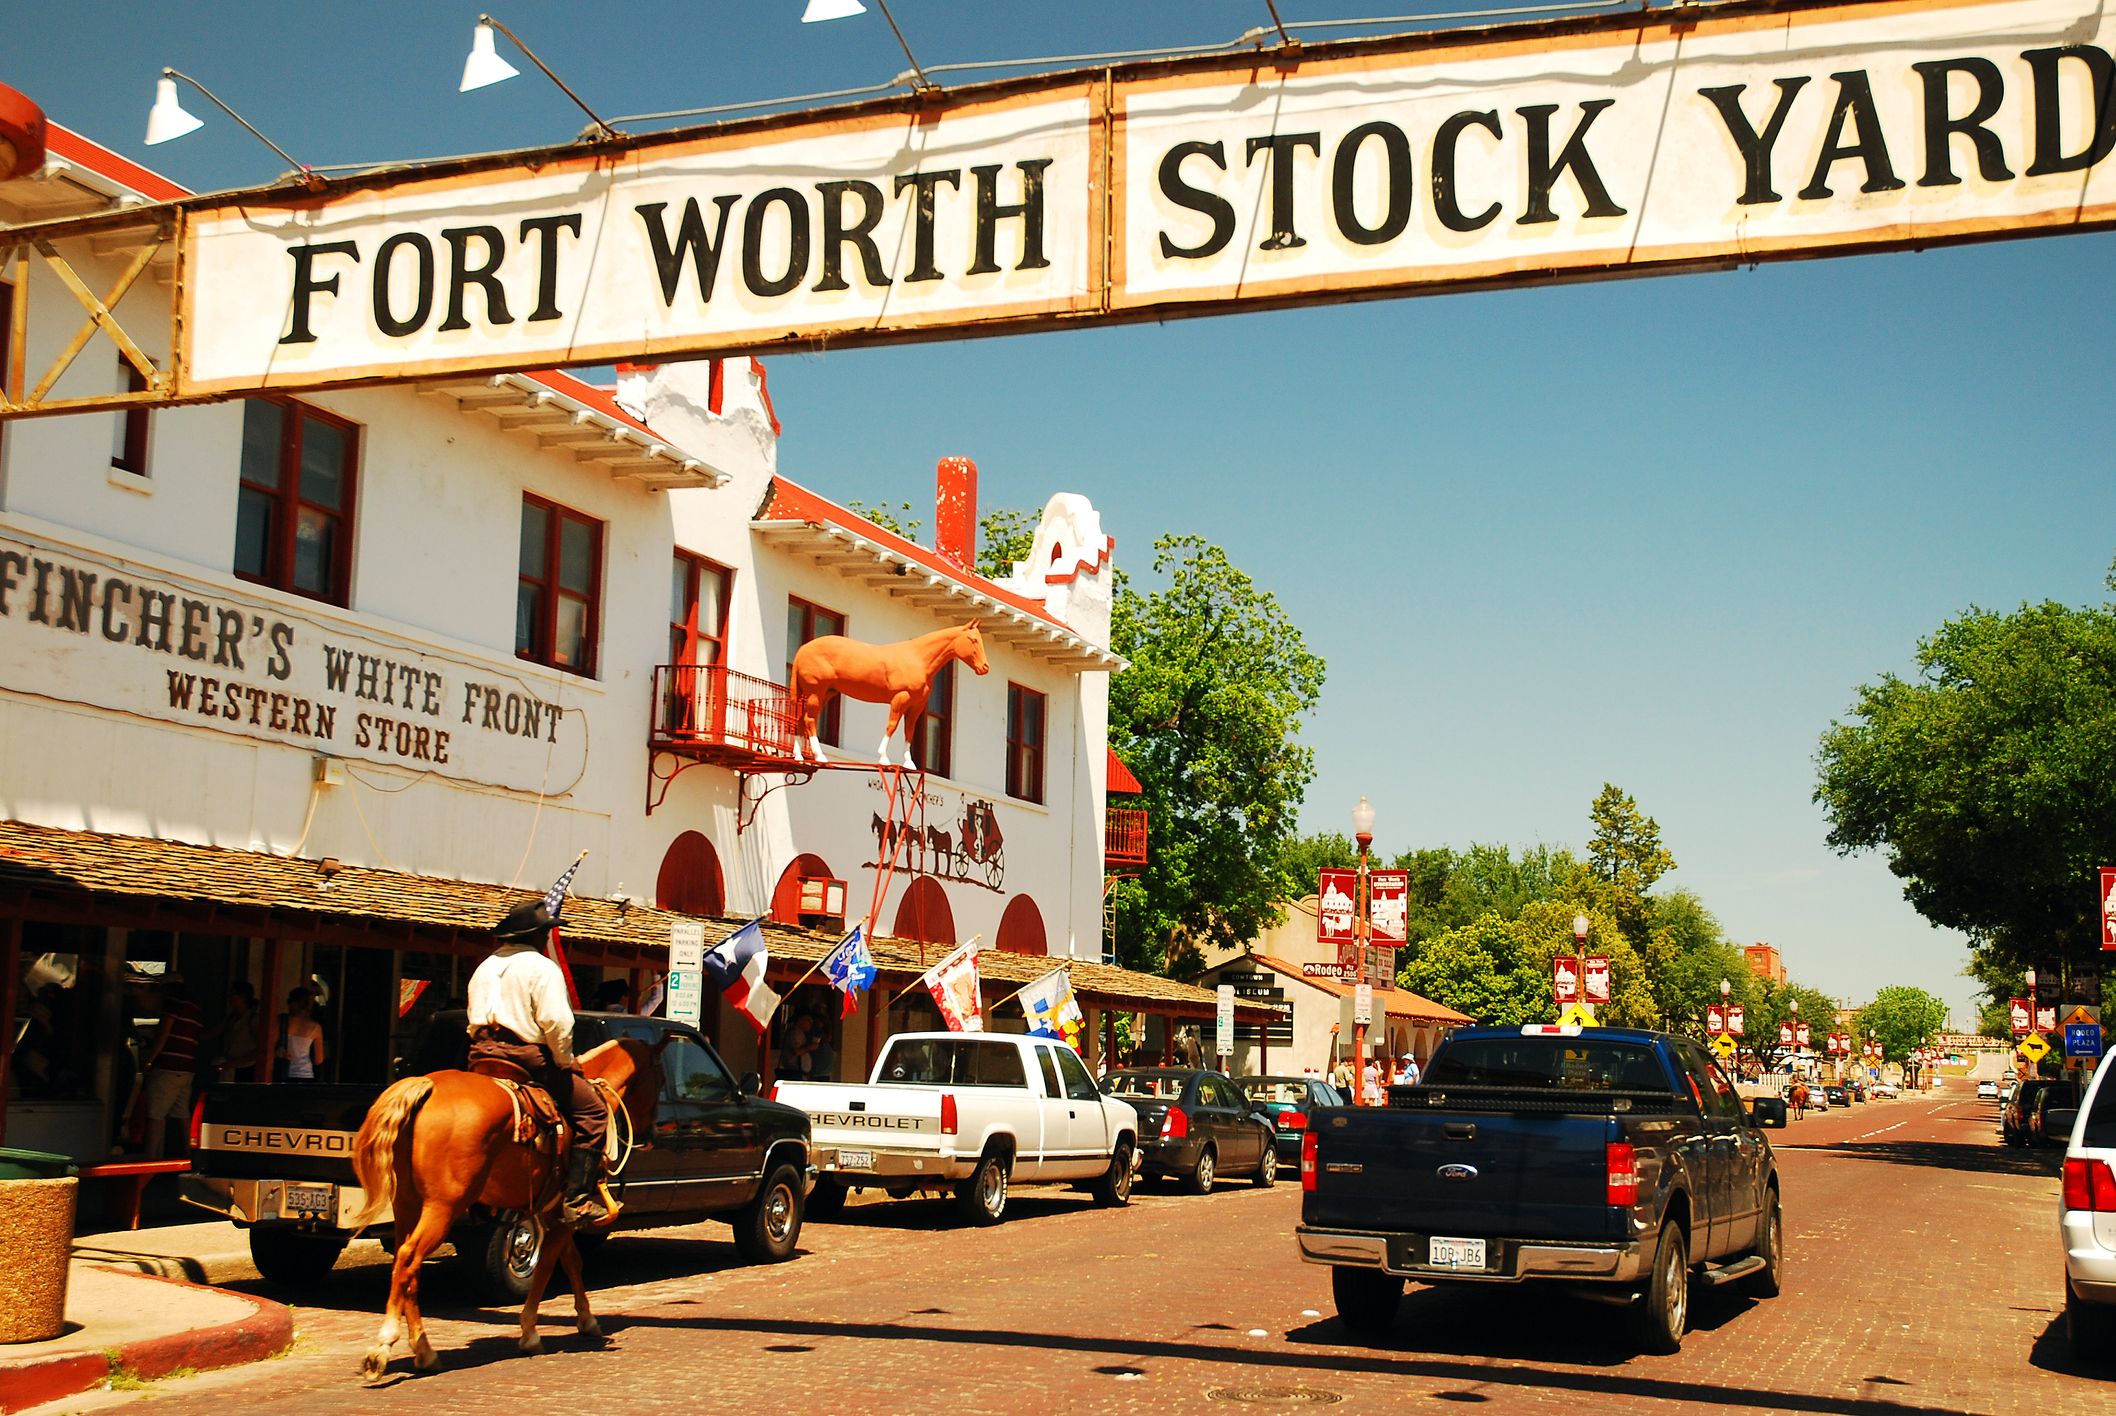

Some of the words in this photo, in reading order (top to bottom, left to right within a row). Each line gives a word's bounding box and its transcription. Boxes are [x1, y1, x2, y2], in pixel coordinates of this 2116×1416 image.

[277, 213, 582, 345] FORT
[634, 158, 1054, 307] WORTH
[1157, 98, 1628, 260] STOCK
[1696, 44, 2116, 206] YARD
[0, 549, 295, 680] FINCHER'S
[323, 644, 442, 715] WHITE
[463, 682, 563, 744] FRONT
[166, 670, 337, 741] WESTERN
[355, 713, 450, 765] STORE
[1314, 963, 1343, 977] Rodeo
[671, 974, 679, 987] 2
[2071, 1029, 2095, 1037] RODEO
[2072, 1039, 2096, 1047] PLAZA
[809, 1113, 924, 1130] HEVROLET
[224, 1129, 352, 1152] CHEVRO
[1445, 1166, 1468, 1179] Ford
